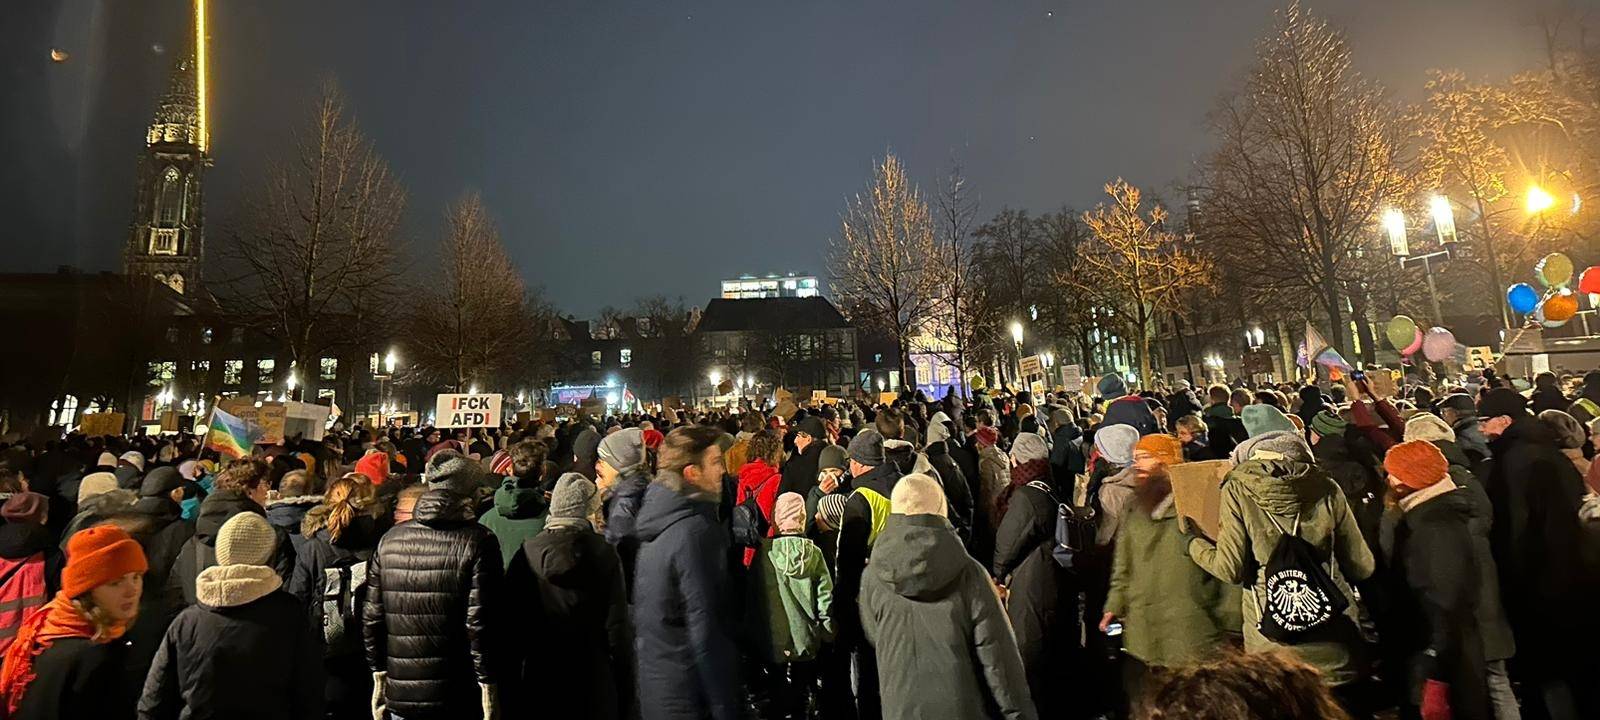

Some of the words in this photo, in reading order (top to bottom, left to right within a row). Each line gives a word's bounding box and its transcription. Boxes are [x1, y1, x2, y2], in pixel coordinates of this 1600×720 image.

[1267, 574, 1279, 589] ZUM
[1277, 570, 1307, 581] BITTERE
[1272, 612, 1286, 626] DIE
